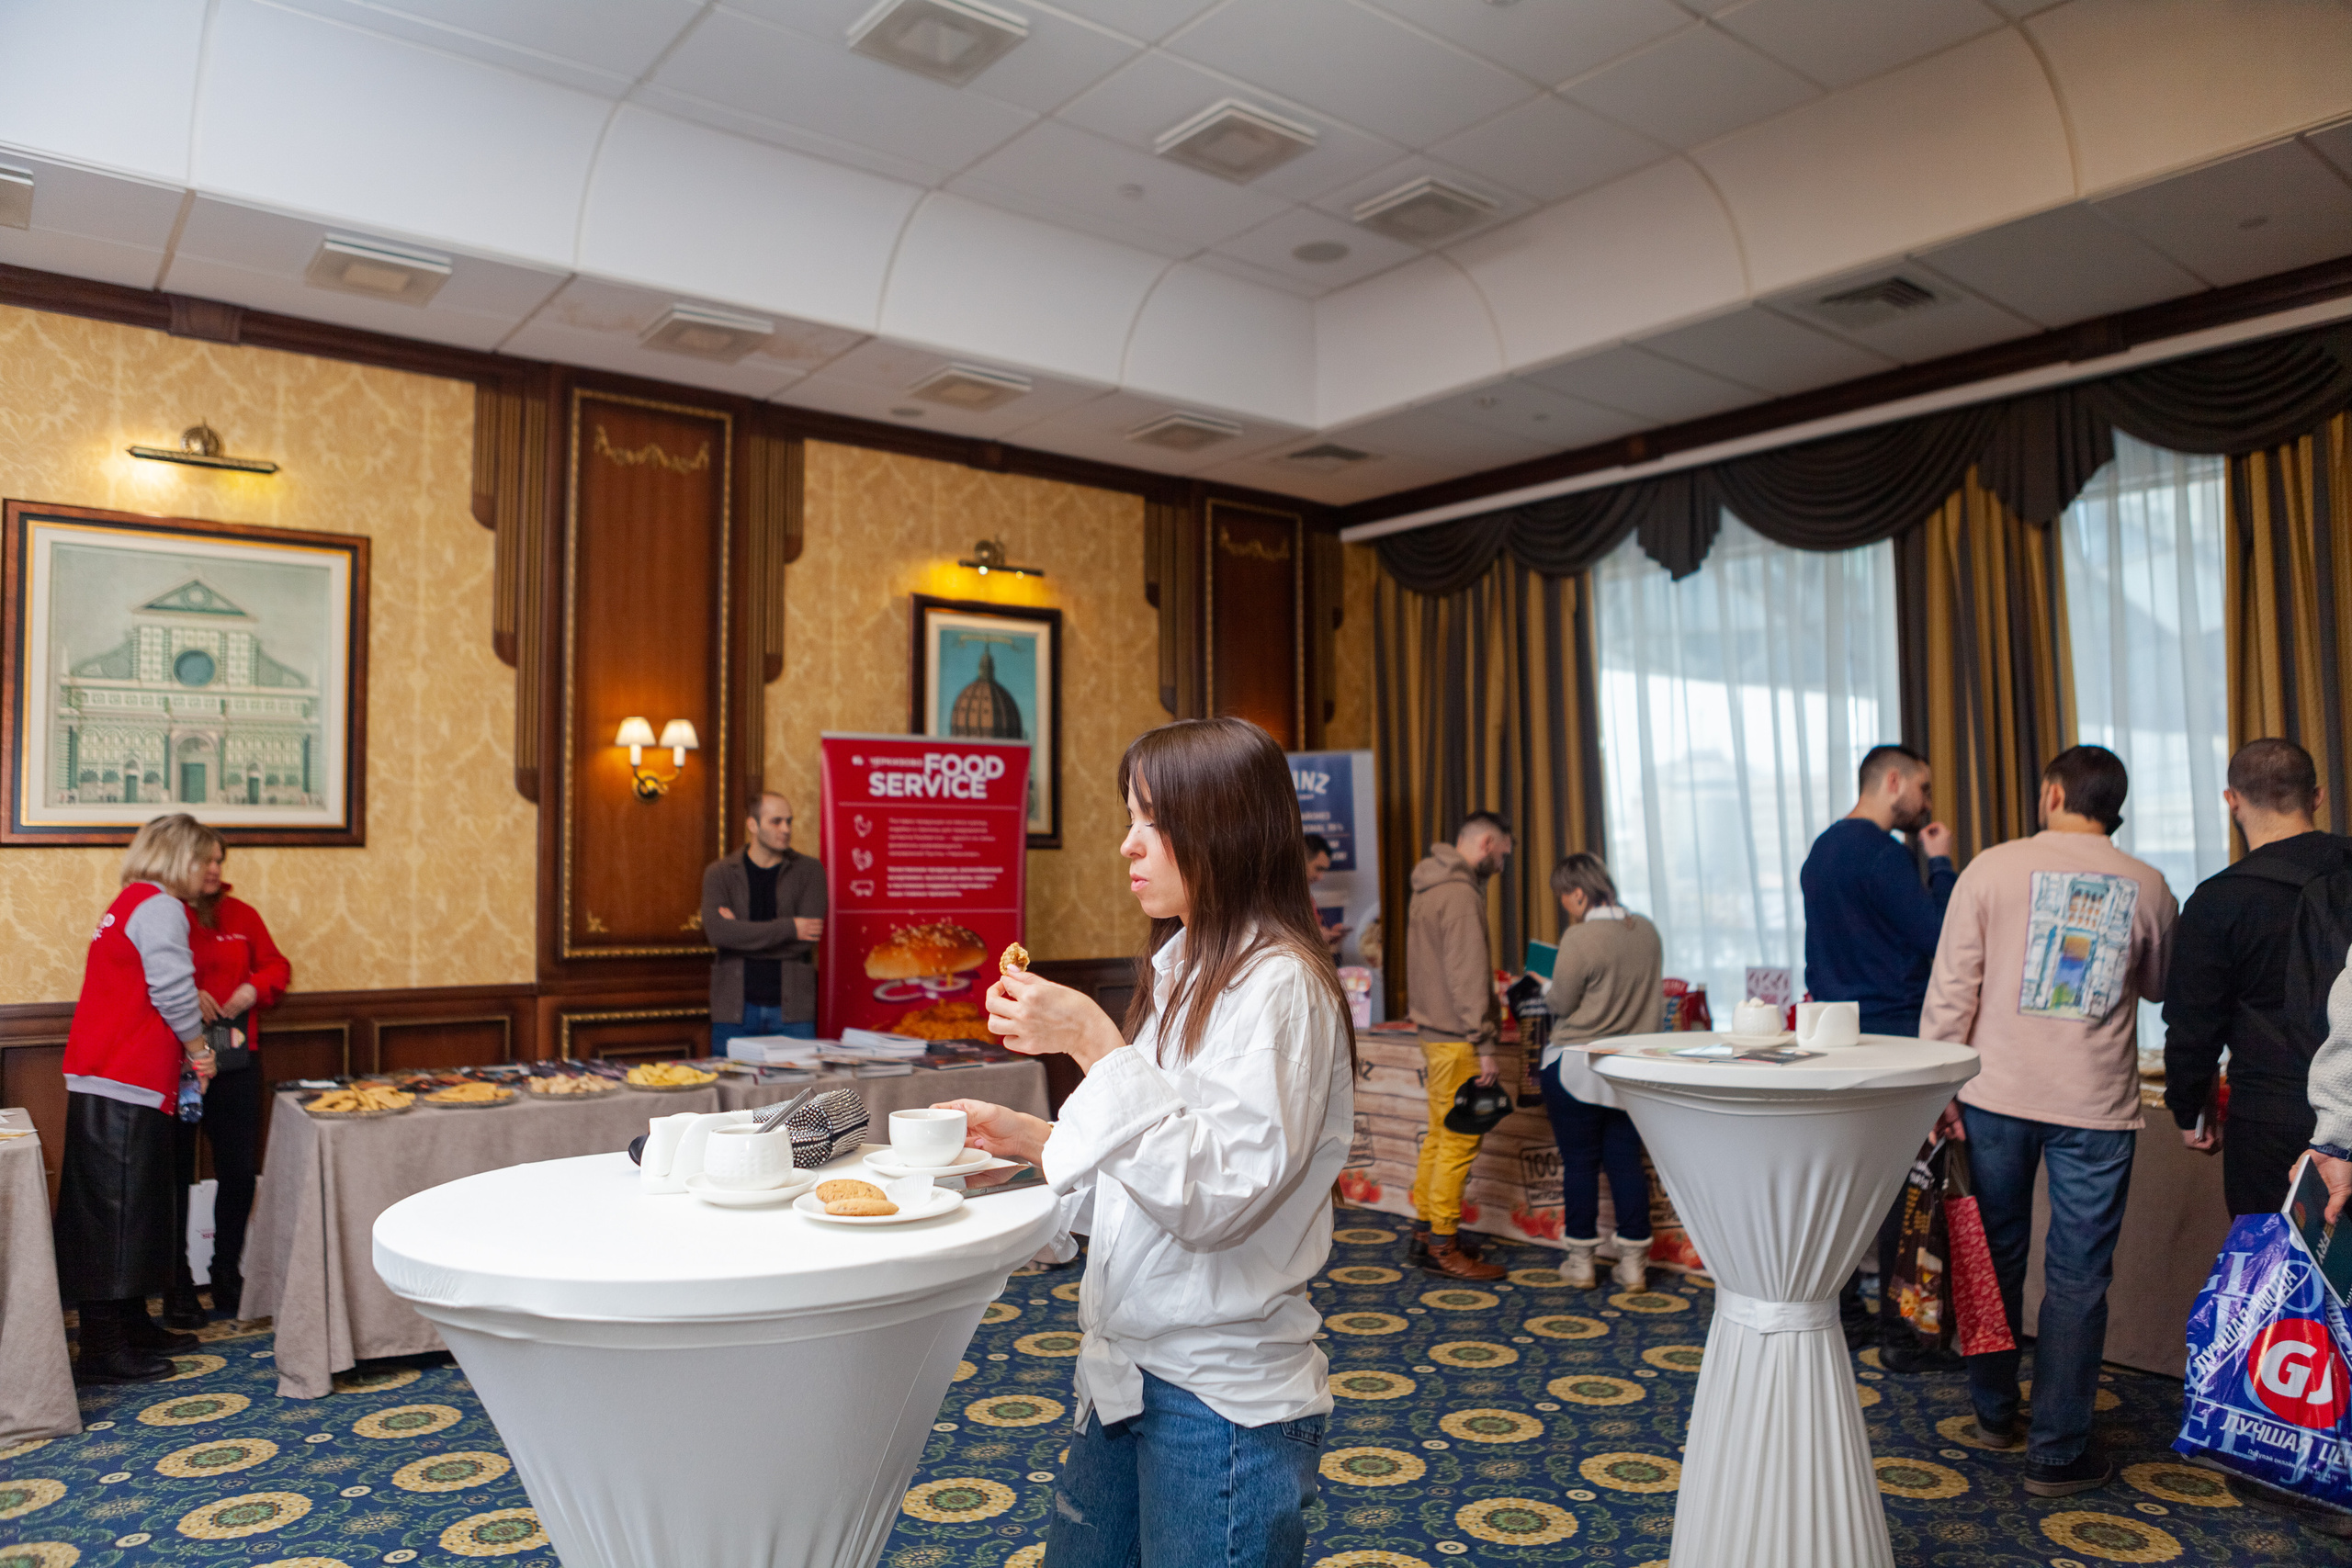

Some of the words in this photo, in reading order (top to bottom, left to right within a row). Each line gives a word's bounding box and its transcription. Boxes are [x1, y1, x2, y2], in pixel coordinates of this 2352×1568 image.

[923, 752, 1005, 779] FOOD
[1292, 770, 1330, 795] INZ
[868, 771, 988, 799] SERVICE
[2314, 1231, 2332, 1266] FRY
[2194, 1307, 2256, 1375] ЛУЧШАЯ
[2251, 1267, 2299, 1315] МОДА
[2260, 1339, 2335, 1405] GJ
[2219, 1414, 2313, 1454] ЛУЧШАЯ
